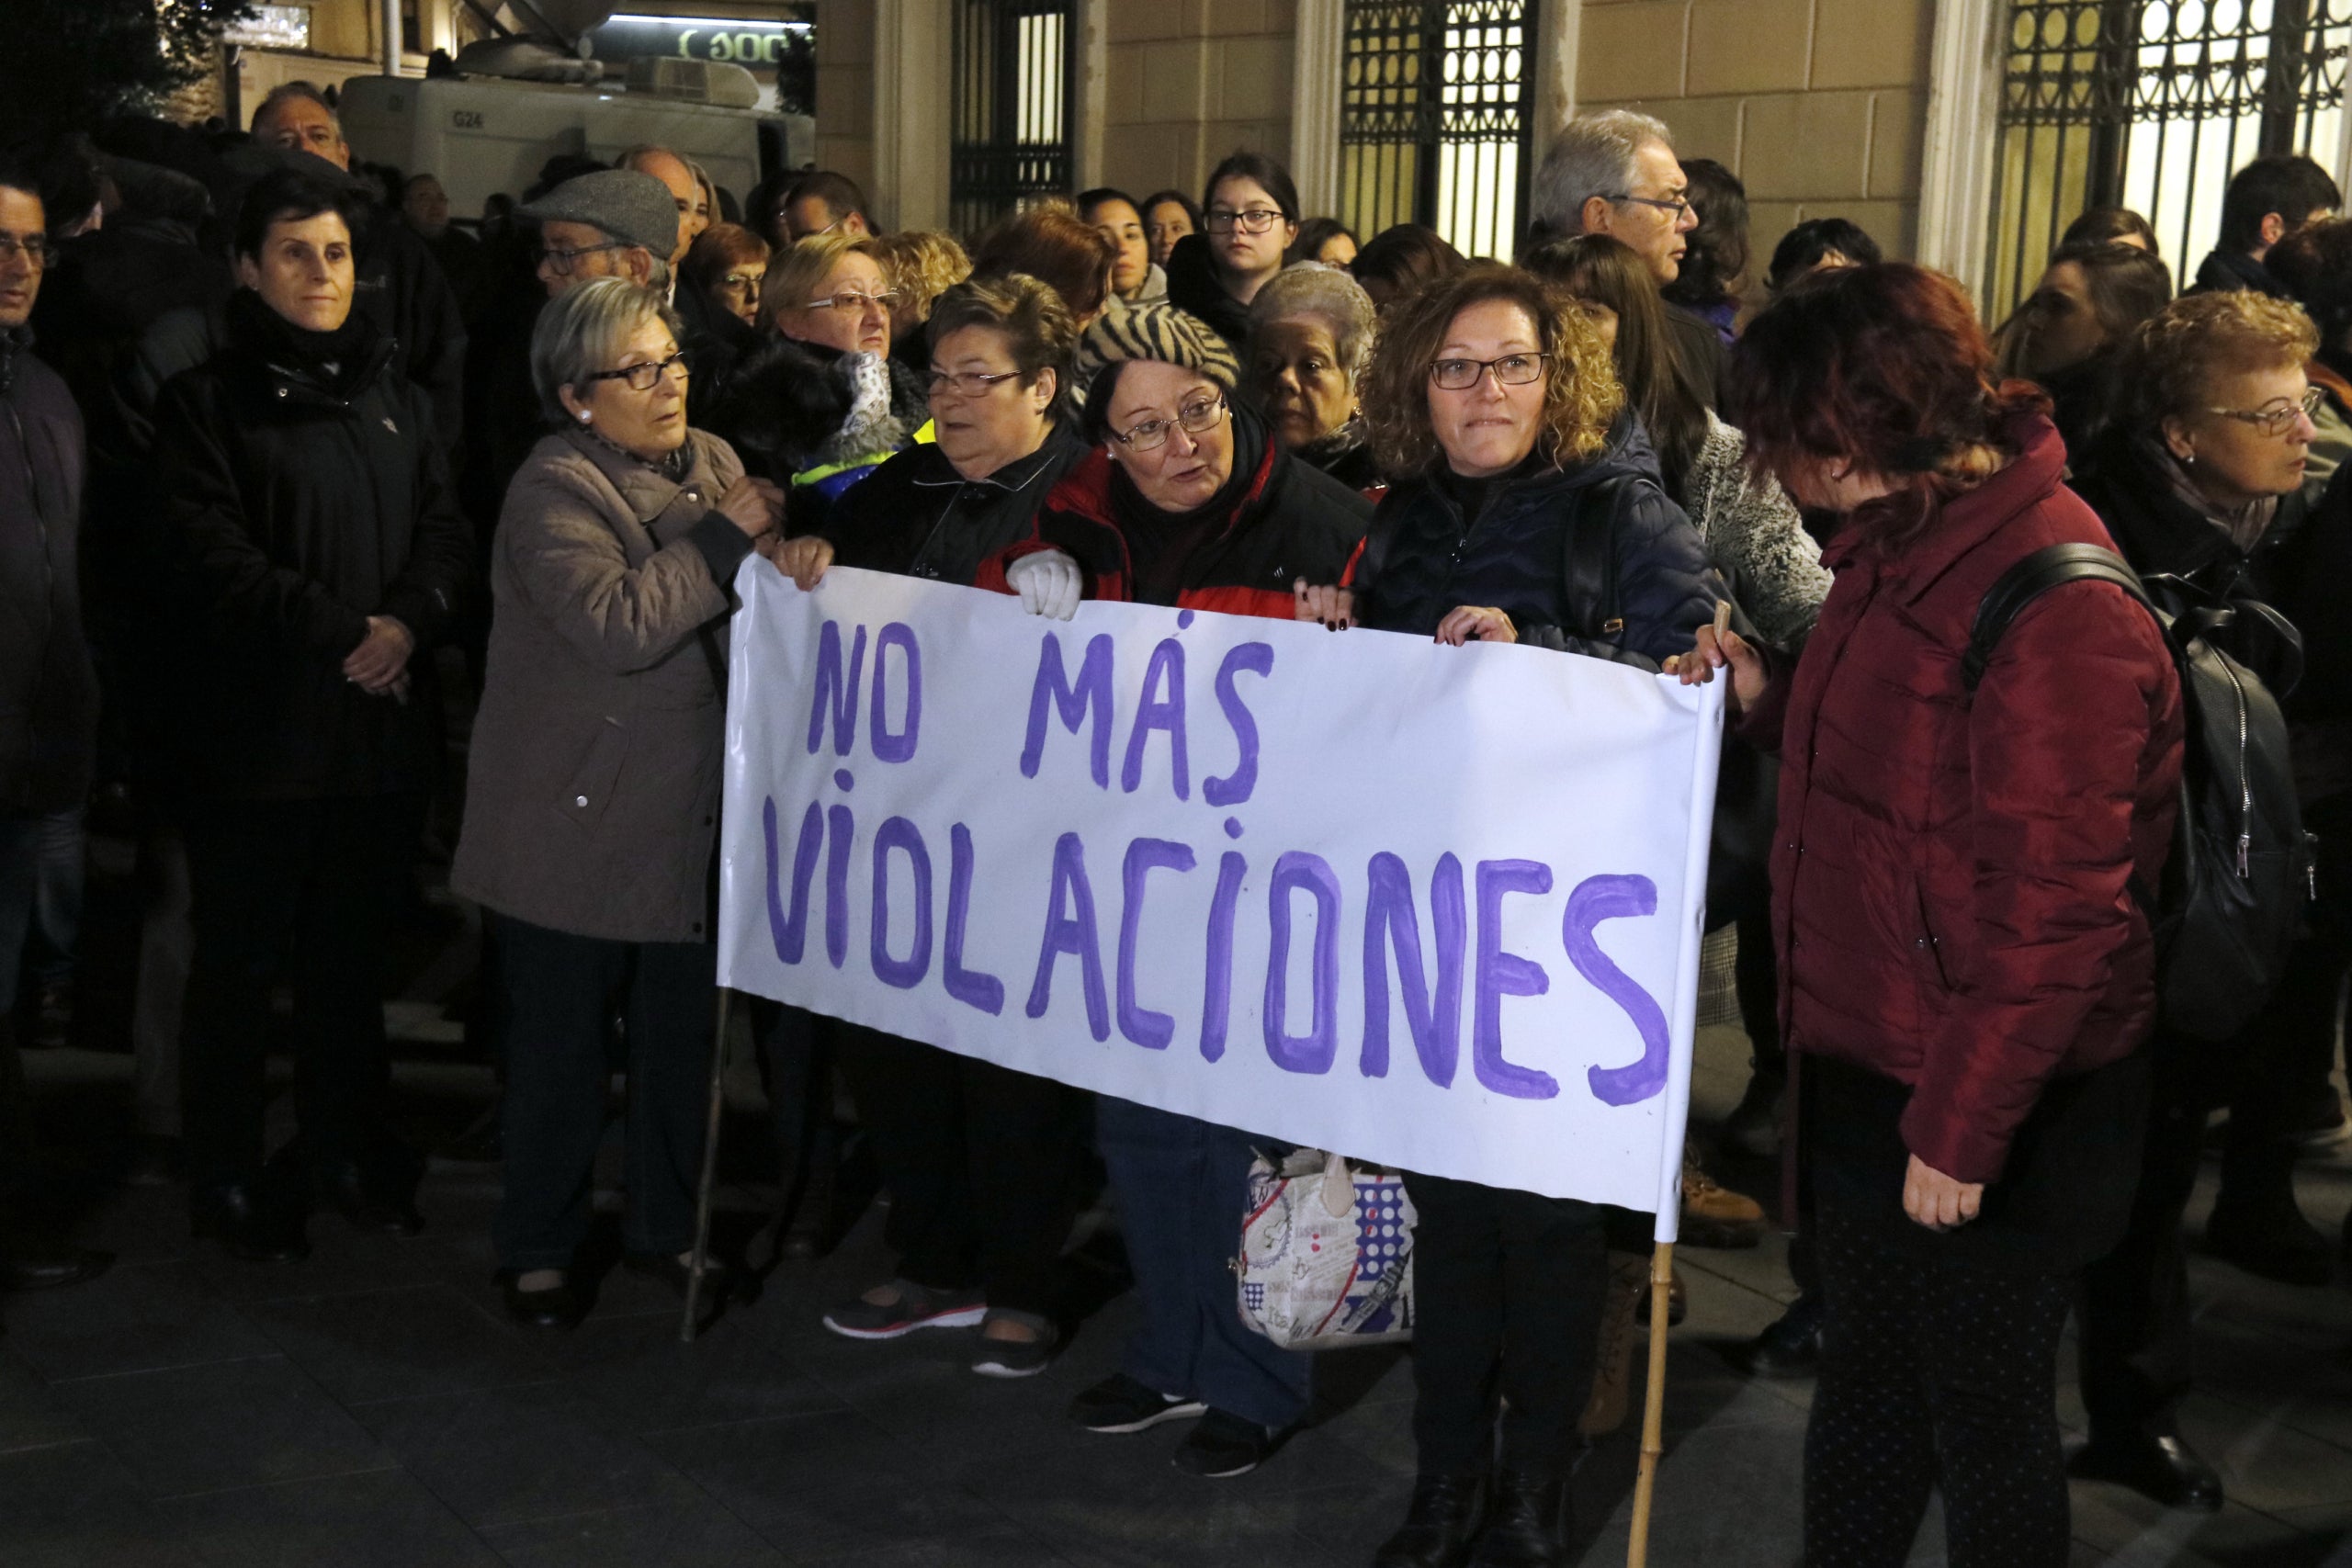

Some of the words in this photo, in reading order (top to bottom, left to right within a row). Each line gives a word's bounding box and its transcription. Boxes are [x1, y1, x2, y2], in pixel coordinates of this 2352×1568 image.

[453, 111, 484, 128] G24
[807, 619, 922, 764] NO
[1020, 609, 1274, 807] MÁS
